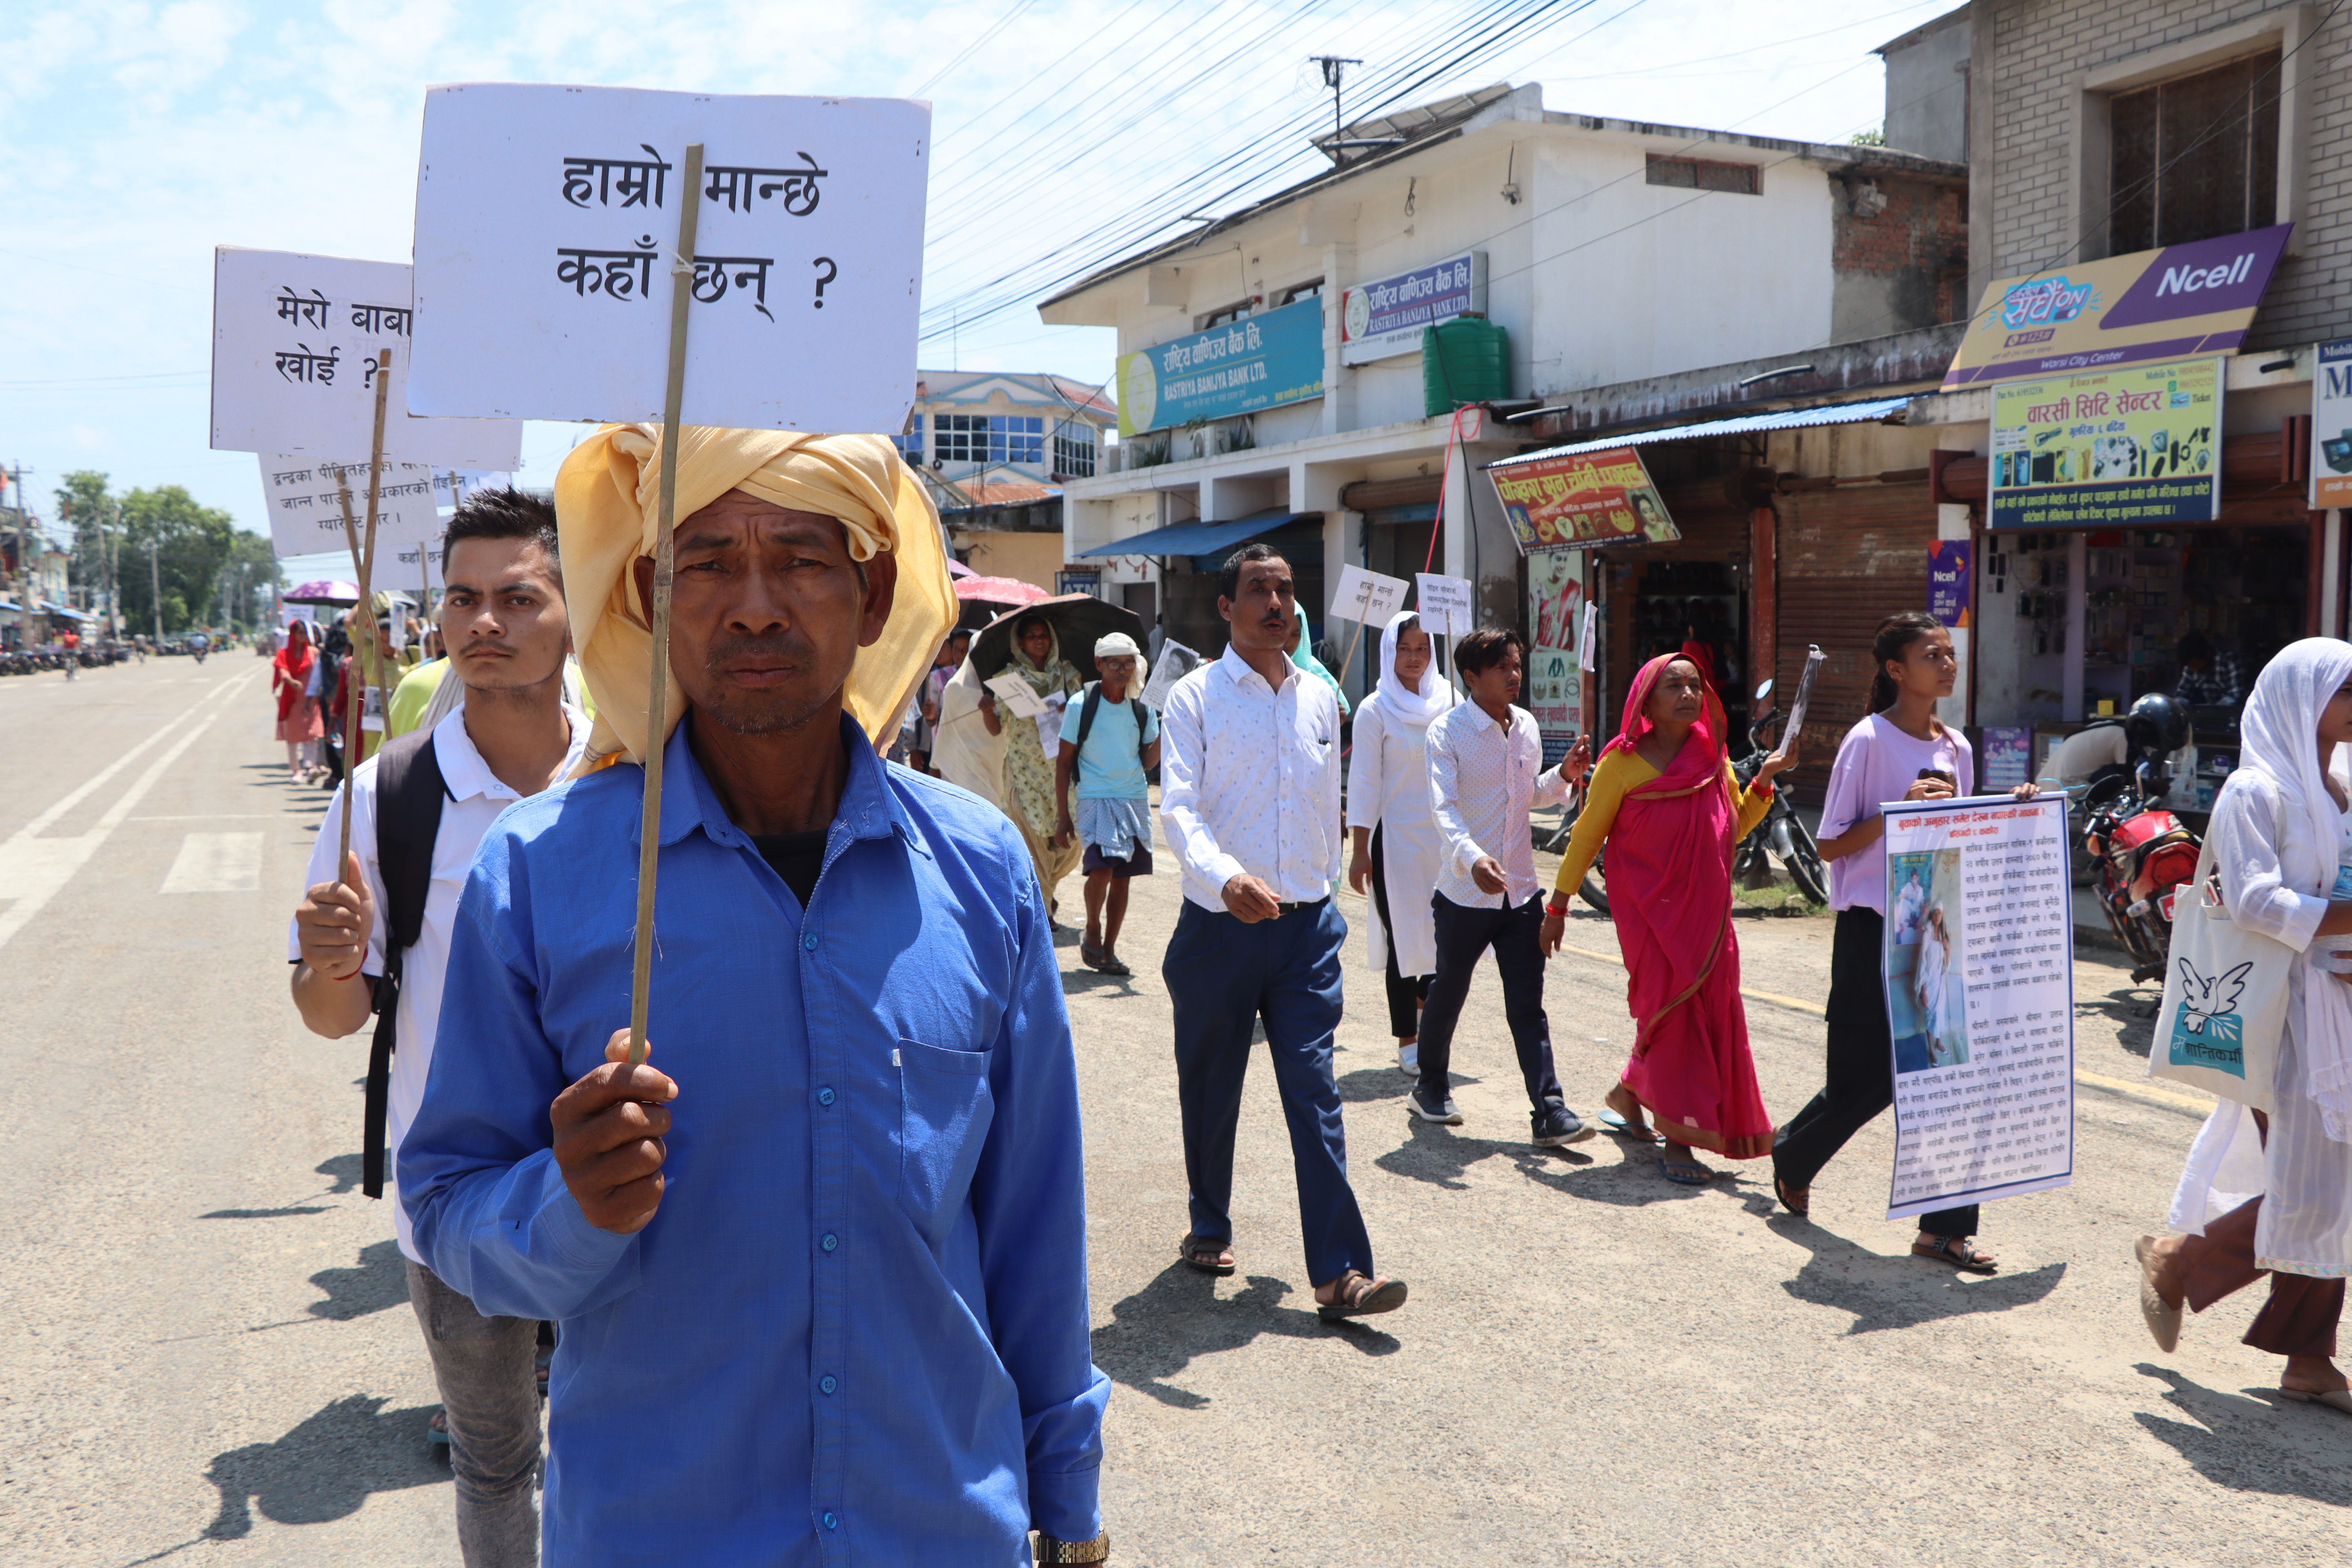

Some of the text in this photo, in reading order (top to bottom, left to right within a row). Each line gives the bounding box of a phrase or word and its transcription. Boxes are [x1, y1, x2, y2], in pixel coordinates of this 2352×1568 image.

[563, 143, 828, 216] हाम्रो मान्छे
[557, 234, 837, 323] कहाँ छन् ?
[1399, 276, 1434, 302] वाणिज्य
[1454, 261, 1470, 288] लि.
[2155, 252, 2255, 298] Ncell
[277, 286, 412, 337] मेरो बाबा
[1369, 295, 1469, 332] RASTRIYA BANIJYA BANK LTD.
[1192, 335, 1226, 364] वाणिज्य
[1247, 322, 1263, 350] लि.
[275, 342, 379, 389] खोई ?
[2069, 354, 2089, 369] City
[2089, 349, 2125, 365] Center
[1164, 377, 1196, 401] RASTRIYA
[1197, 371, 1227, 394] BANIJYA
[1229, 364, 1249, 387] BANK
[1250, 361, 1267, 382] LTD.
[2027, 388, 2164, 423] वारसी सिटि सेन्टर
[2192, 393, 2211, 403] Ticket
[272, 470, 312, 486] द्वन्द्वका
[1598, 462, 1643, 488] पसल
[280, 495, 312, 510] जान्न
[1933, 570, 1956, 582] Ncell
[1063, 583, 1099, 597] ATM
[1378, 586, 1394, 597] मान्छे
[1386, 602, 1392, 611] ?
[1898, 816, 1922, 831] बुवाको
[1924, 815, 1950, 829] अनुहार
[1952, 812, 1970, 824] समेत
[1965, 874, 1975, 884] गते
[1978, 873, 1990, 883] राती
[1967, 966, 1984, 978] पाएको
